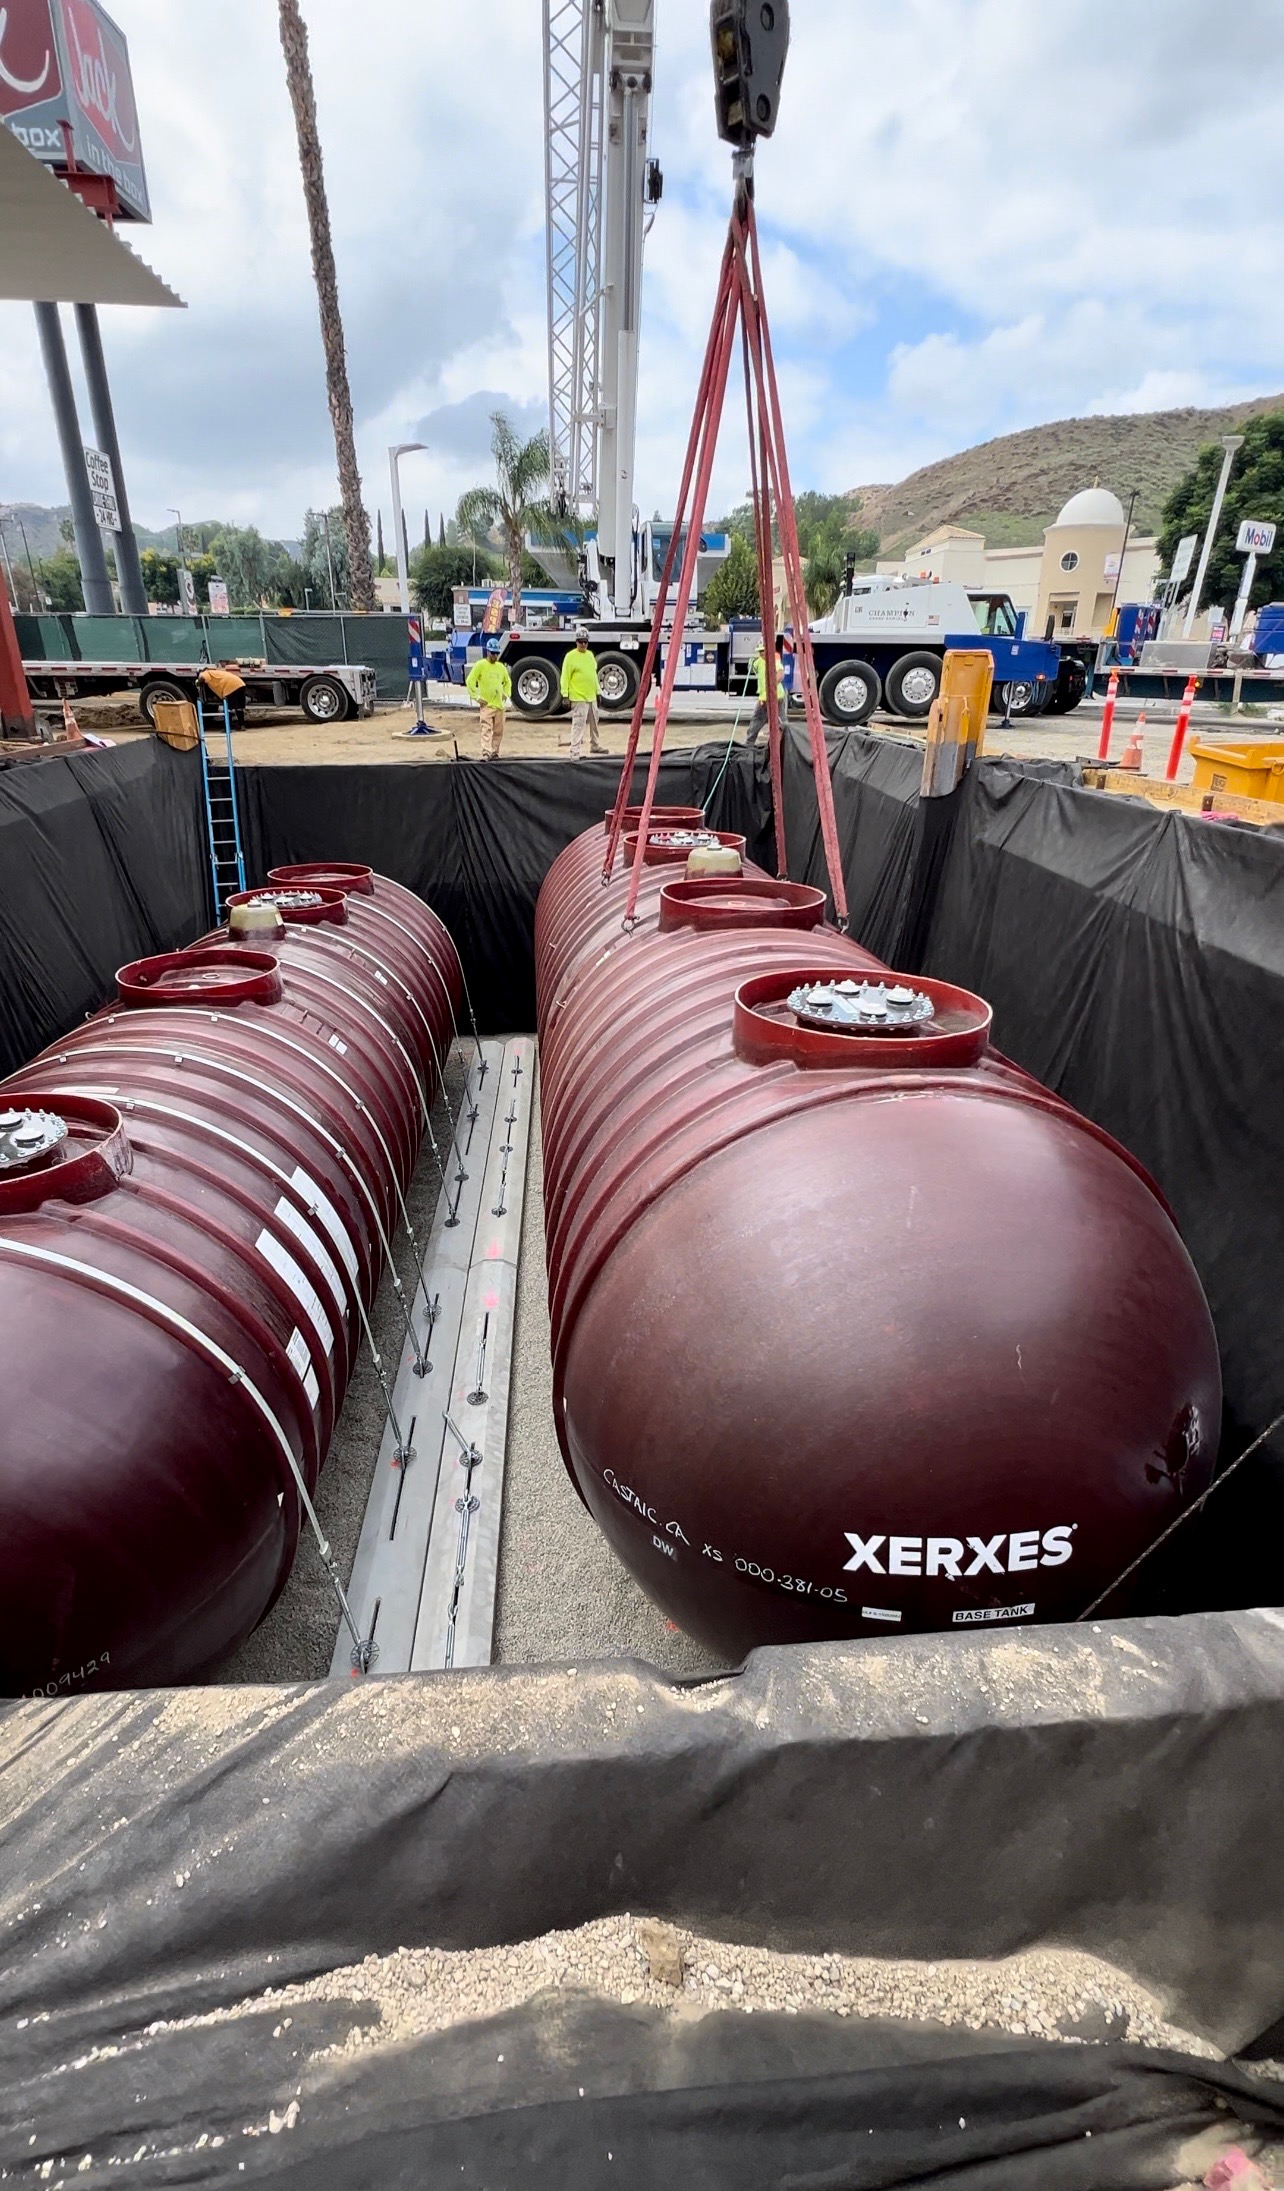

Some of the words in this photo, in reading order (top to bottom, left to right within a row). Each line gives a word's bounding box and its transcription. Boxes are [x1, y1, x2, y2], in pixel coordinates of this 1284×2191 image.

[85, 451, 109, 474] Coffee
[91, 471, 109, 493] Stop
[1245, 527, 1273, 548] Mobil
[652, 1535, 674, 1557] DW
[665, 1521, 691, 1546] CA
[702, 1543, 723, 1562] XS
[842, 1525, 1074, 1577] XERXES
[955, 1610, 992, 1621] BASE
[994, 1605, 1029, 1618] TANK
